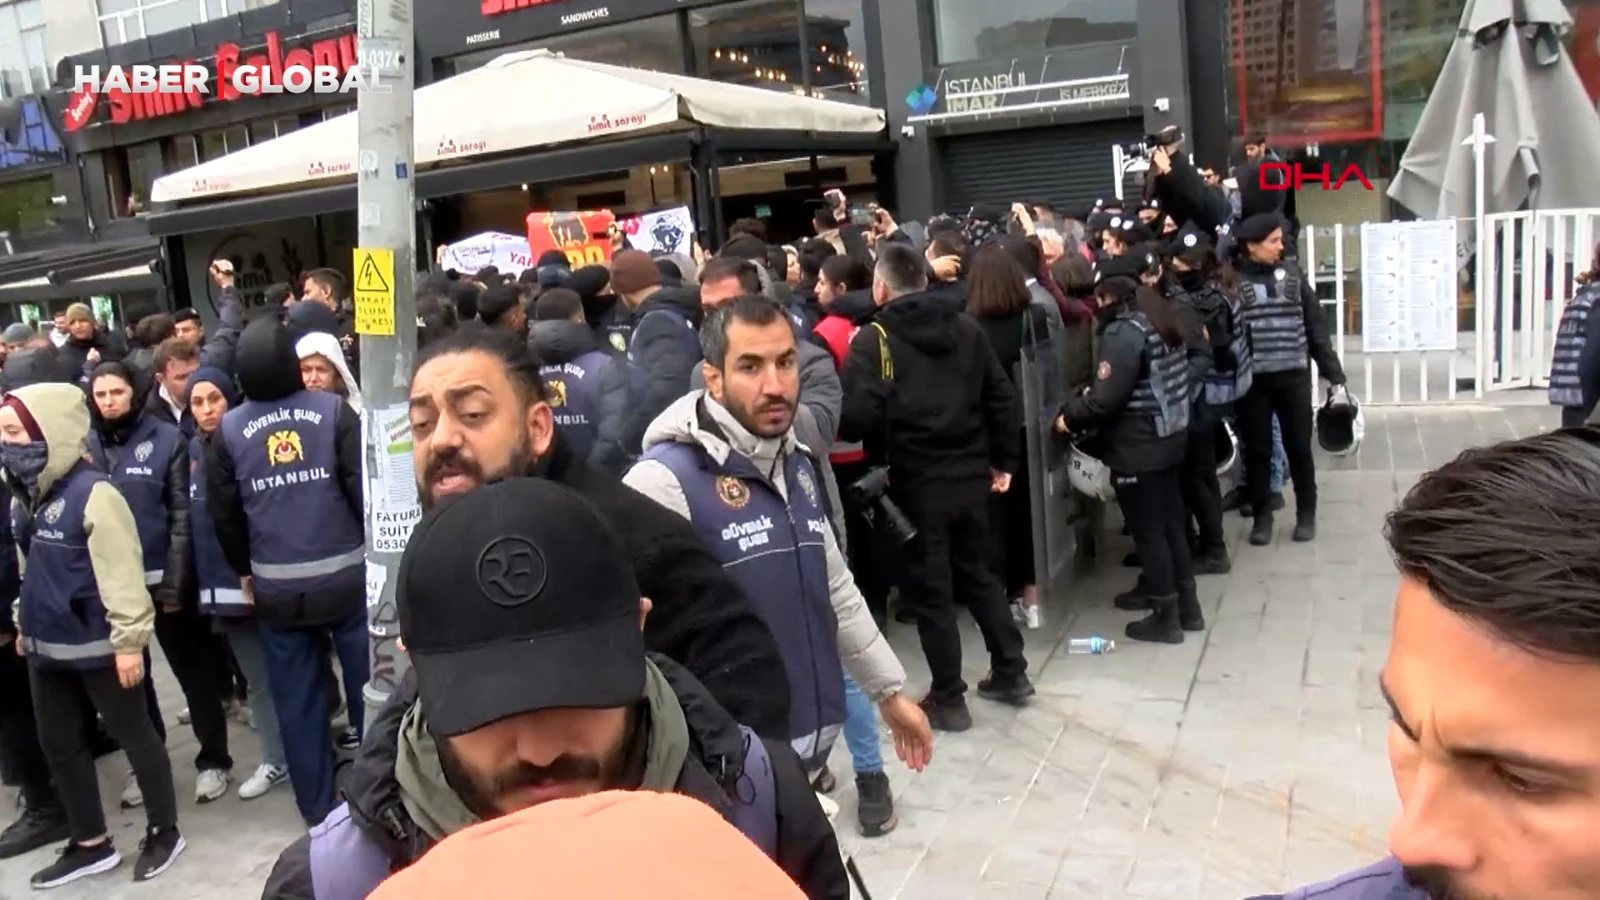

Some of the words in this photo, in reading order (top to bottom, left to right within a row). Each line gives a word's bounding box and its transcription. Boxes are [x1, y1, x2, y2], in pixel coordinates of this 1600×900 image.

[560, 7, 609, 25] SANDWICHES
[466, 29, 501, 45] PATISSERIE
[588, 115, 611, 132] simit
[243, 407, 292, 439] GÜVENLİK
[294, 408, 323, 425] ŞUBE
[252, 467, 331, 492] İSTANBUL
[721, 514, 774, 541] GÜVENLİK
